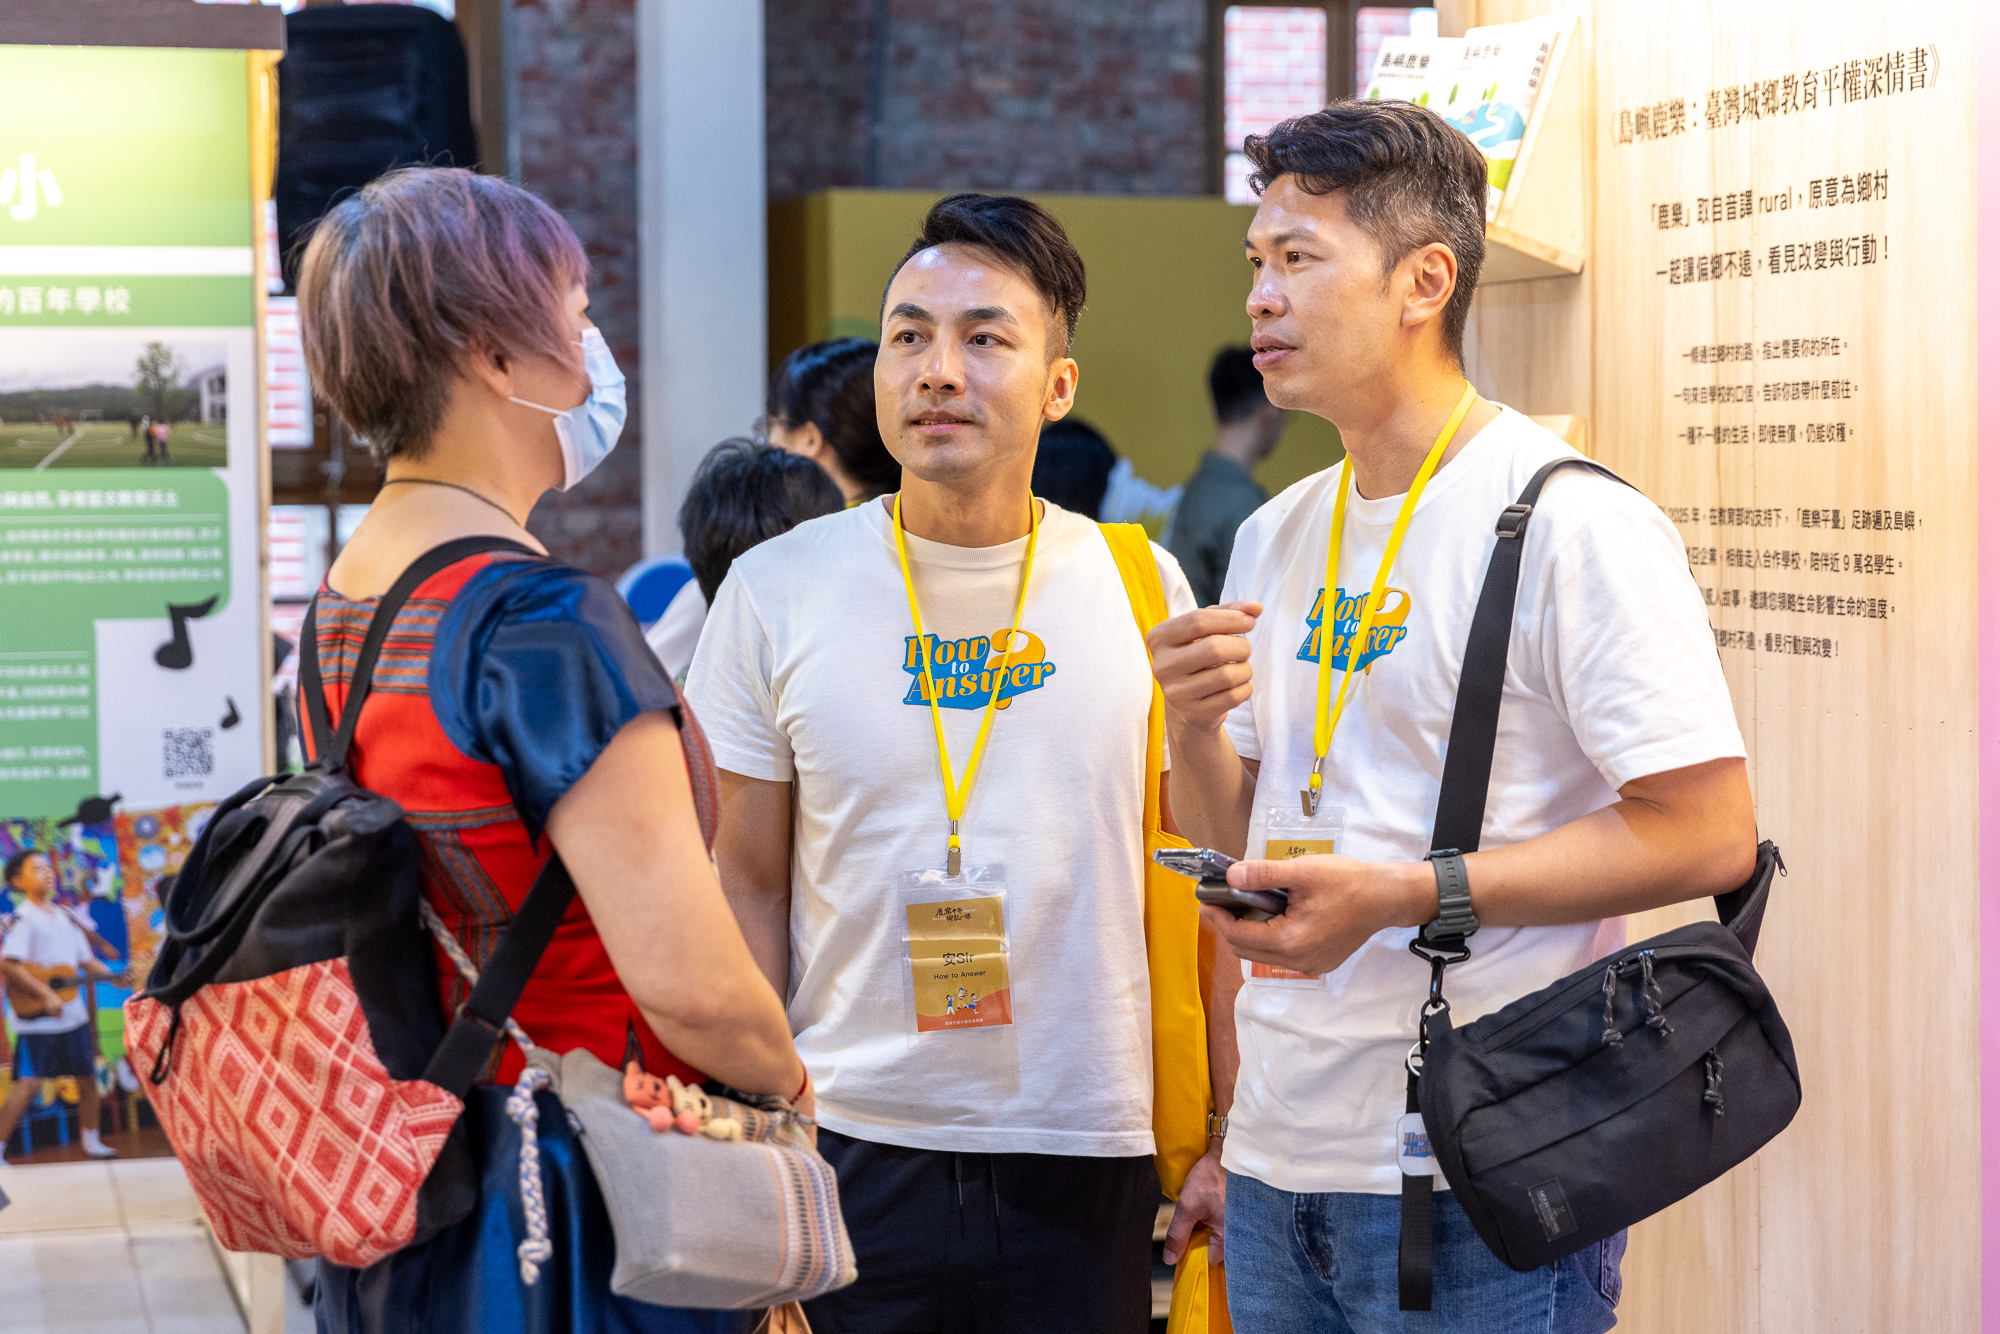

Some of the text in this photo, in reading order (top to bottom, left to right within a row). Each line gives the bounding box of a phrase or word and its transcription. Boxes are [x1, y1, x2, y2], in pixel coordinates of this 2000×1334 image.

[1610, 43, 1940, 147] 《島嶼鹿樂：臺灣城鄉教育平權深情書》
[0, 153, 63, 221] 小
[1656, 233, 1889, 286] 一起讓偏鄉不遠，看見改變與行動！
[1699, 588, 1896, 620] 感人故事，邀請您領略生命影響生命的溫度。
[1343, 618, 1360, 634] to
[905, 635, 988, 669] How
[951, 661, 970, 675] to
[905, 663, 1053, 702] Answer
[942, 952, 974, 967] 安Sir
[960, 969, 986, 978] Answer
